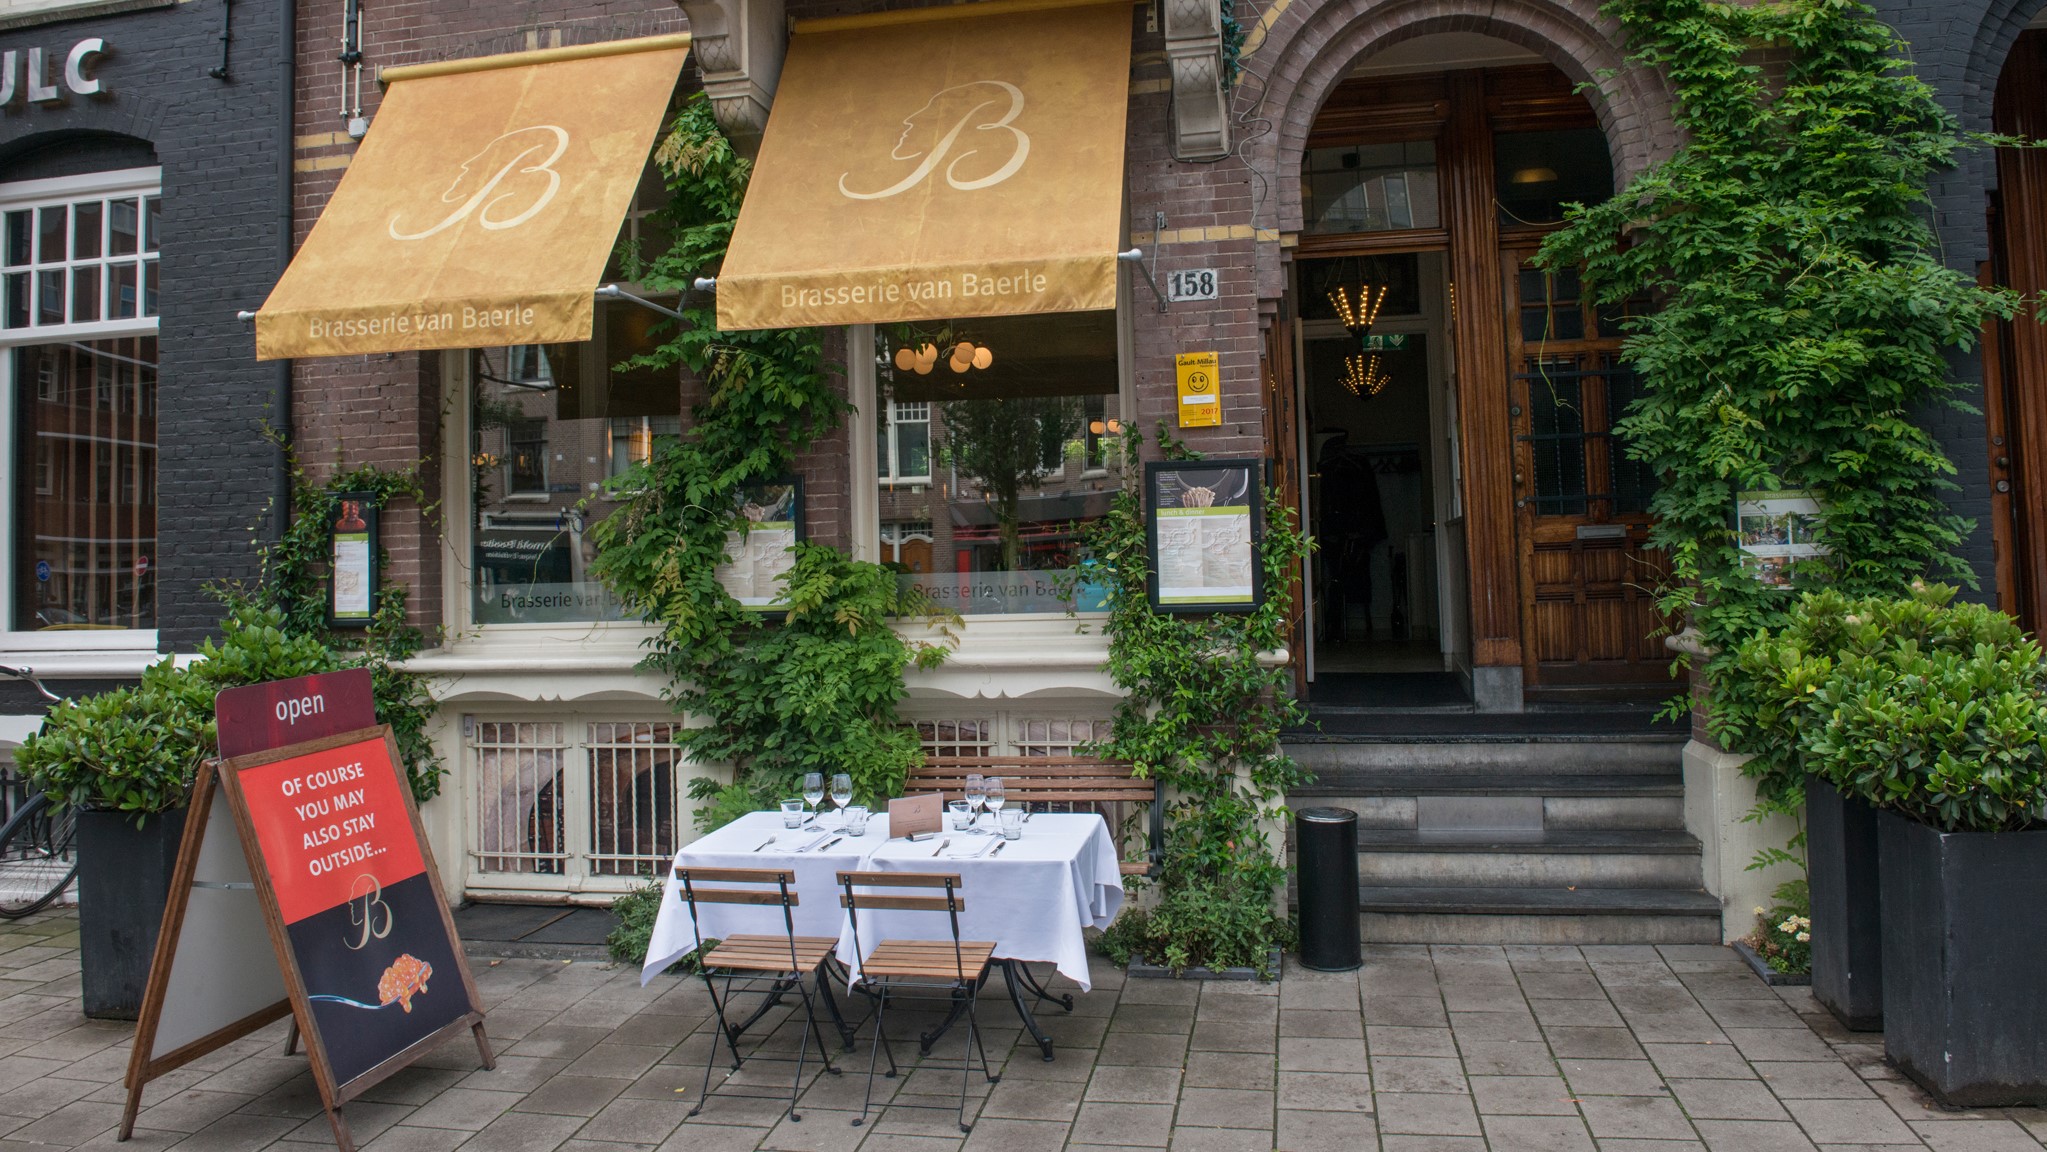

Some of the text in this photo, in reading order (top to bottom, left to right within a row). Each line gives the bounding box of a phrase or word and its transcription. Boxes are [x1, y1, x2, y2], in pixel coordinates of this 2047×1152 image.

[781, 268, 1047, 308] Brasserie van Baerle
[1172, 272, 1214, 297] 158
[309, 303, 534, 338] Brasserie van Baerle
[501, 592, 572, 609] Brasserie
[913, 581, 993, 599] Brasserie
[1000, 584, 1029, 597] van
[275, 694, 325, 725] open
[281, 762, 365, 797] OF COURSE
[295, 788, 366, 822] YOU MAY
[303, 813, 376, 850] ALSO STAY
[309, 841, 387, 876] OUTSIDE...
